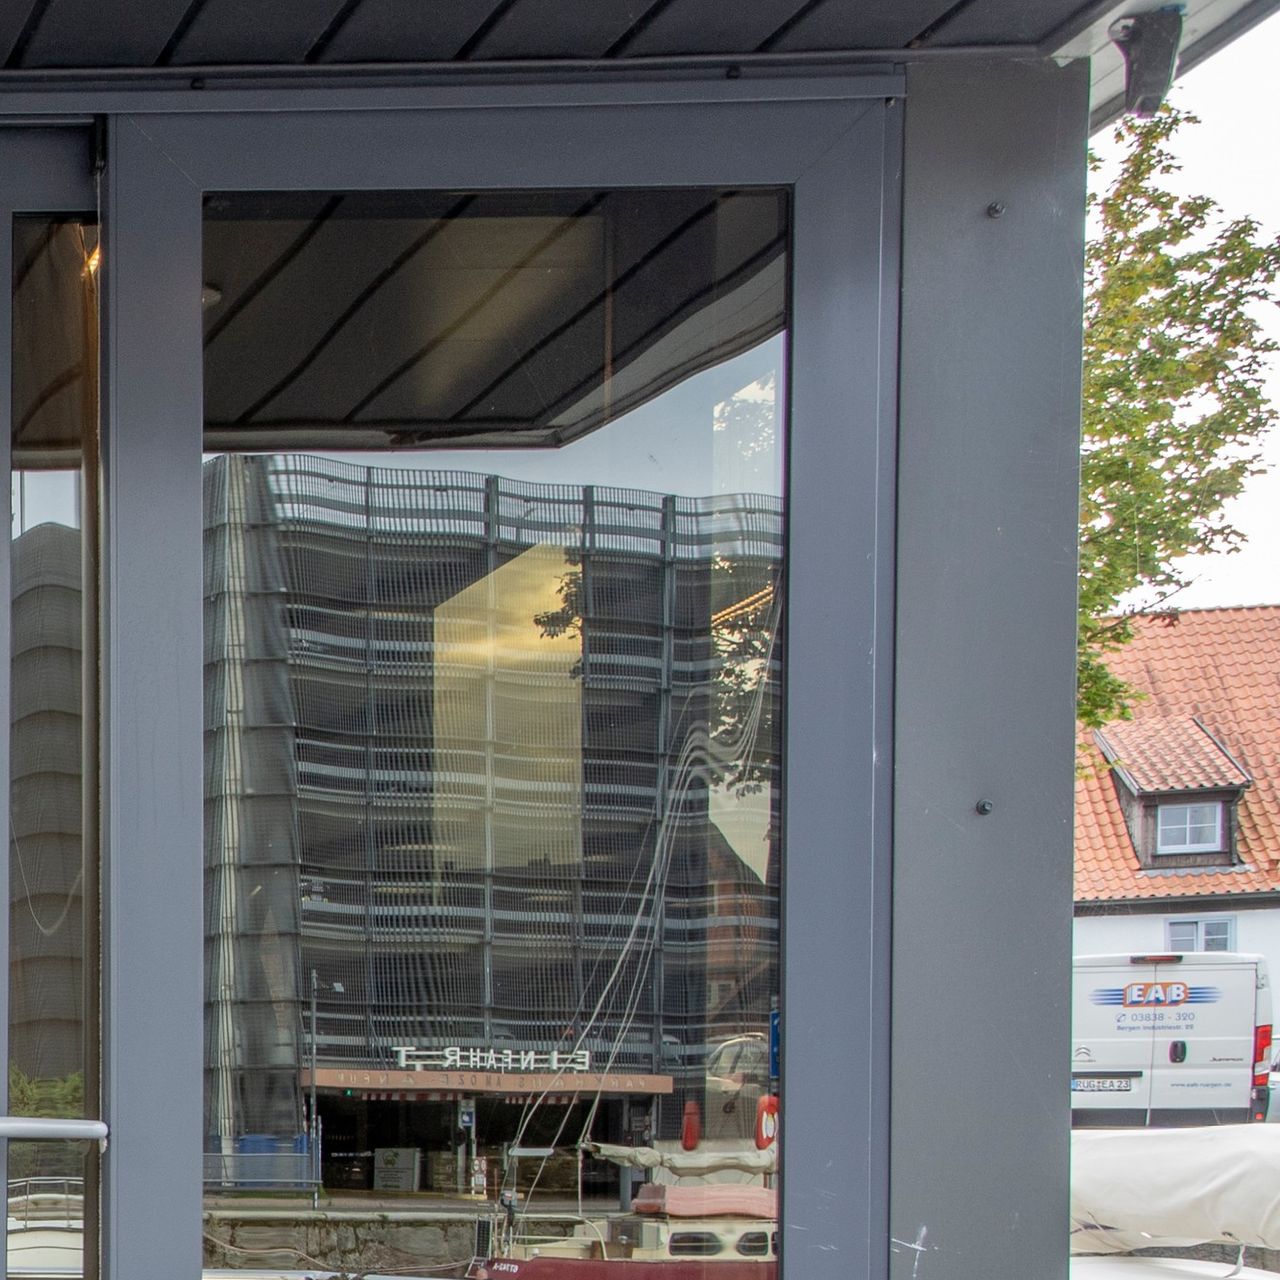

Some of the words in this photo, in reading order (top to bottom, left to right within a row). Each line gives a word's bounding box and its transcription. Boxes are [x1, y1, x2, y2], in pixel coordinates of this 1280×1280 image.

[1127, 983, 1186, 1004] EAB
[1131, 1012, 1165, 1022] 03838
[1116, 1080, 1129, 1089] 23
